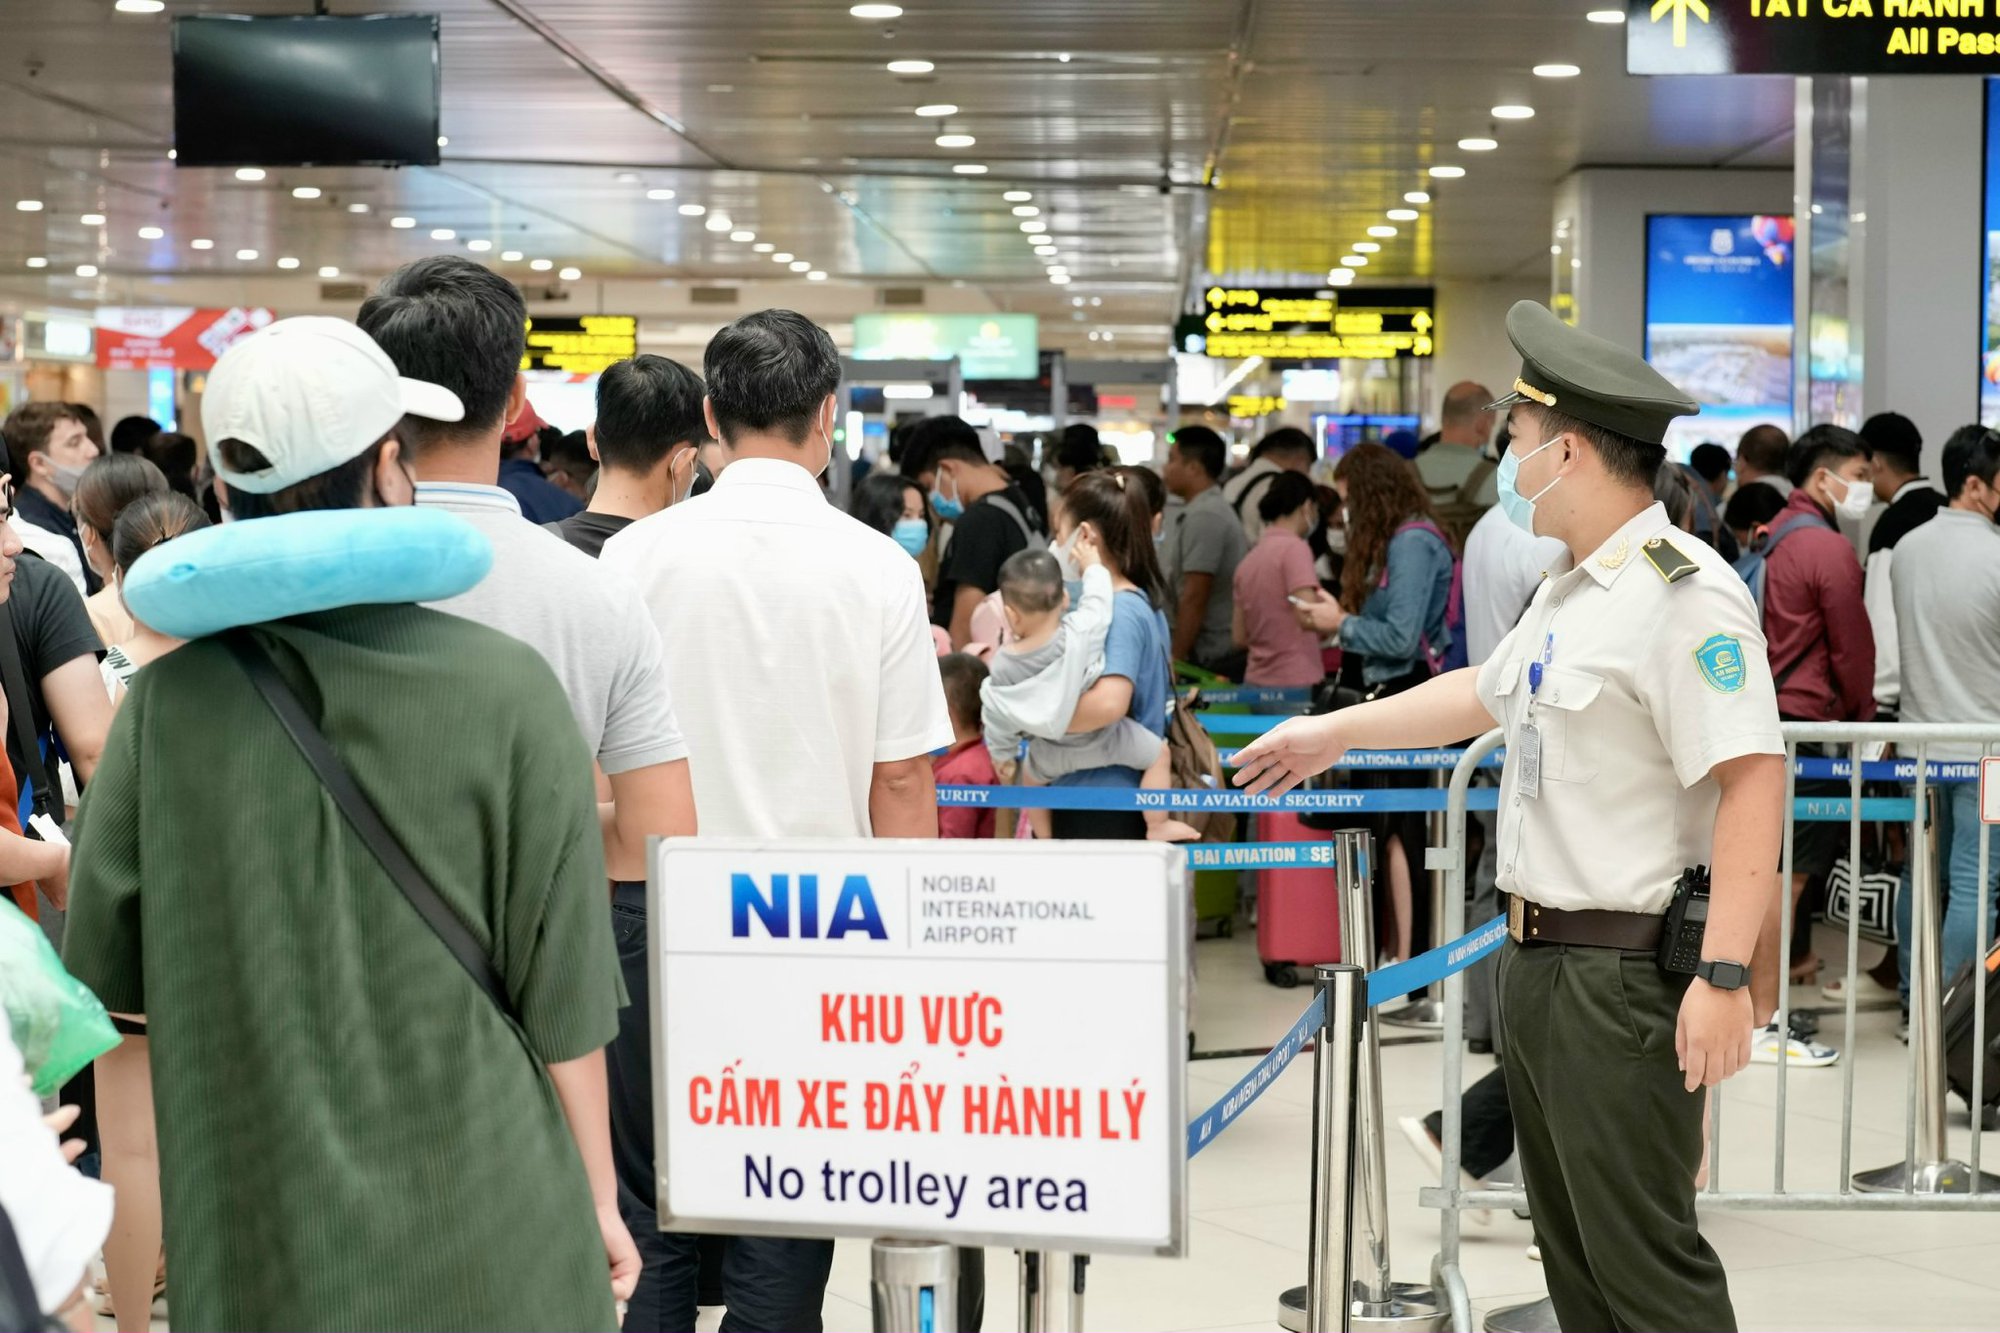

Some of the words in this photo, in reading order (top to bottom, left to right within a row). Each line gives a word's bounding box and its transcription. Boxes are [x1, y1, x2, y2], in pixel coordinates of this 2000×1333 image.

[1886, 27, 1929, 54] All
[1937, 27, 2000, 55] Pas
[935, 790, 989, 802] CURITY
[1136, 793, 1165, 806] NOI
[1171, 794, 1198, 806] BAI
[1203, 794, 1281, 807] AVIATION
[1285, 795, 1365, 807] SECURITY
[1194, 850, 1220, 865] BAI
[1224, 847, 1296, 864] AVIATION
[922, 876, 996, 893] NOIBAI
[730, 873, 889, 940] NIA
[922, 900, 1095, 920] INTERNATIONAL
[922, 926, 1018, 944] AIRPORT
[821, 993, 904, 1043] KHU
[920, 991, 1003, 1058] VỰC
[689, 1059, 781, 1128] CẤM
[797, 1080, 848, 1129] XE
[864, 1061, 946, 1132] ĐẨY
[963, 1075, 1082, 1138] HÀNH
[1099, 1078, 1147, 1141] LÝ
[744, 1155, 804, 1200] No
[821, 1159, 968, 1219] trolley
[987, 1174, 1089, 1212] area
